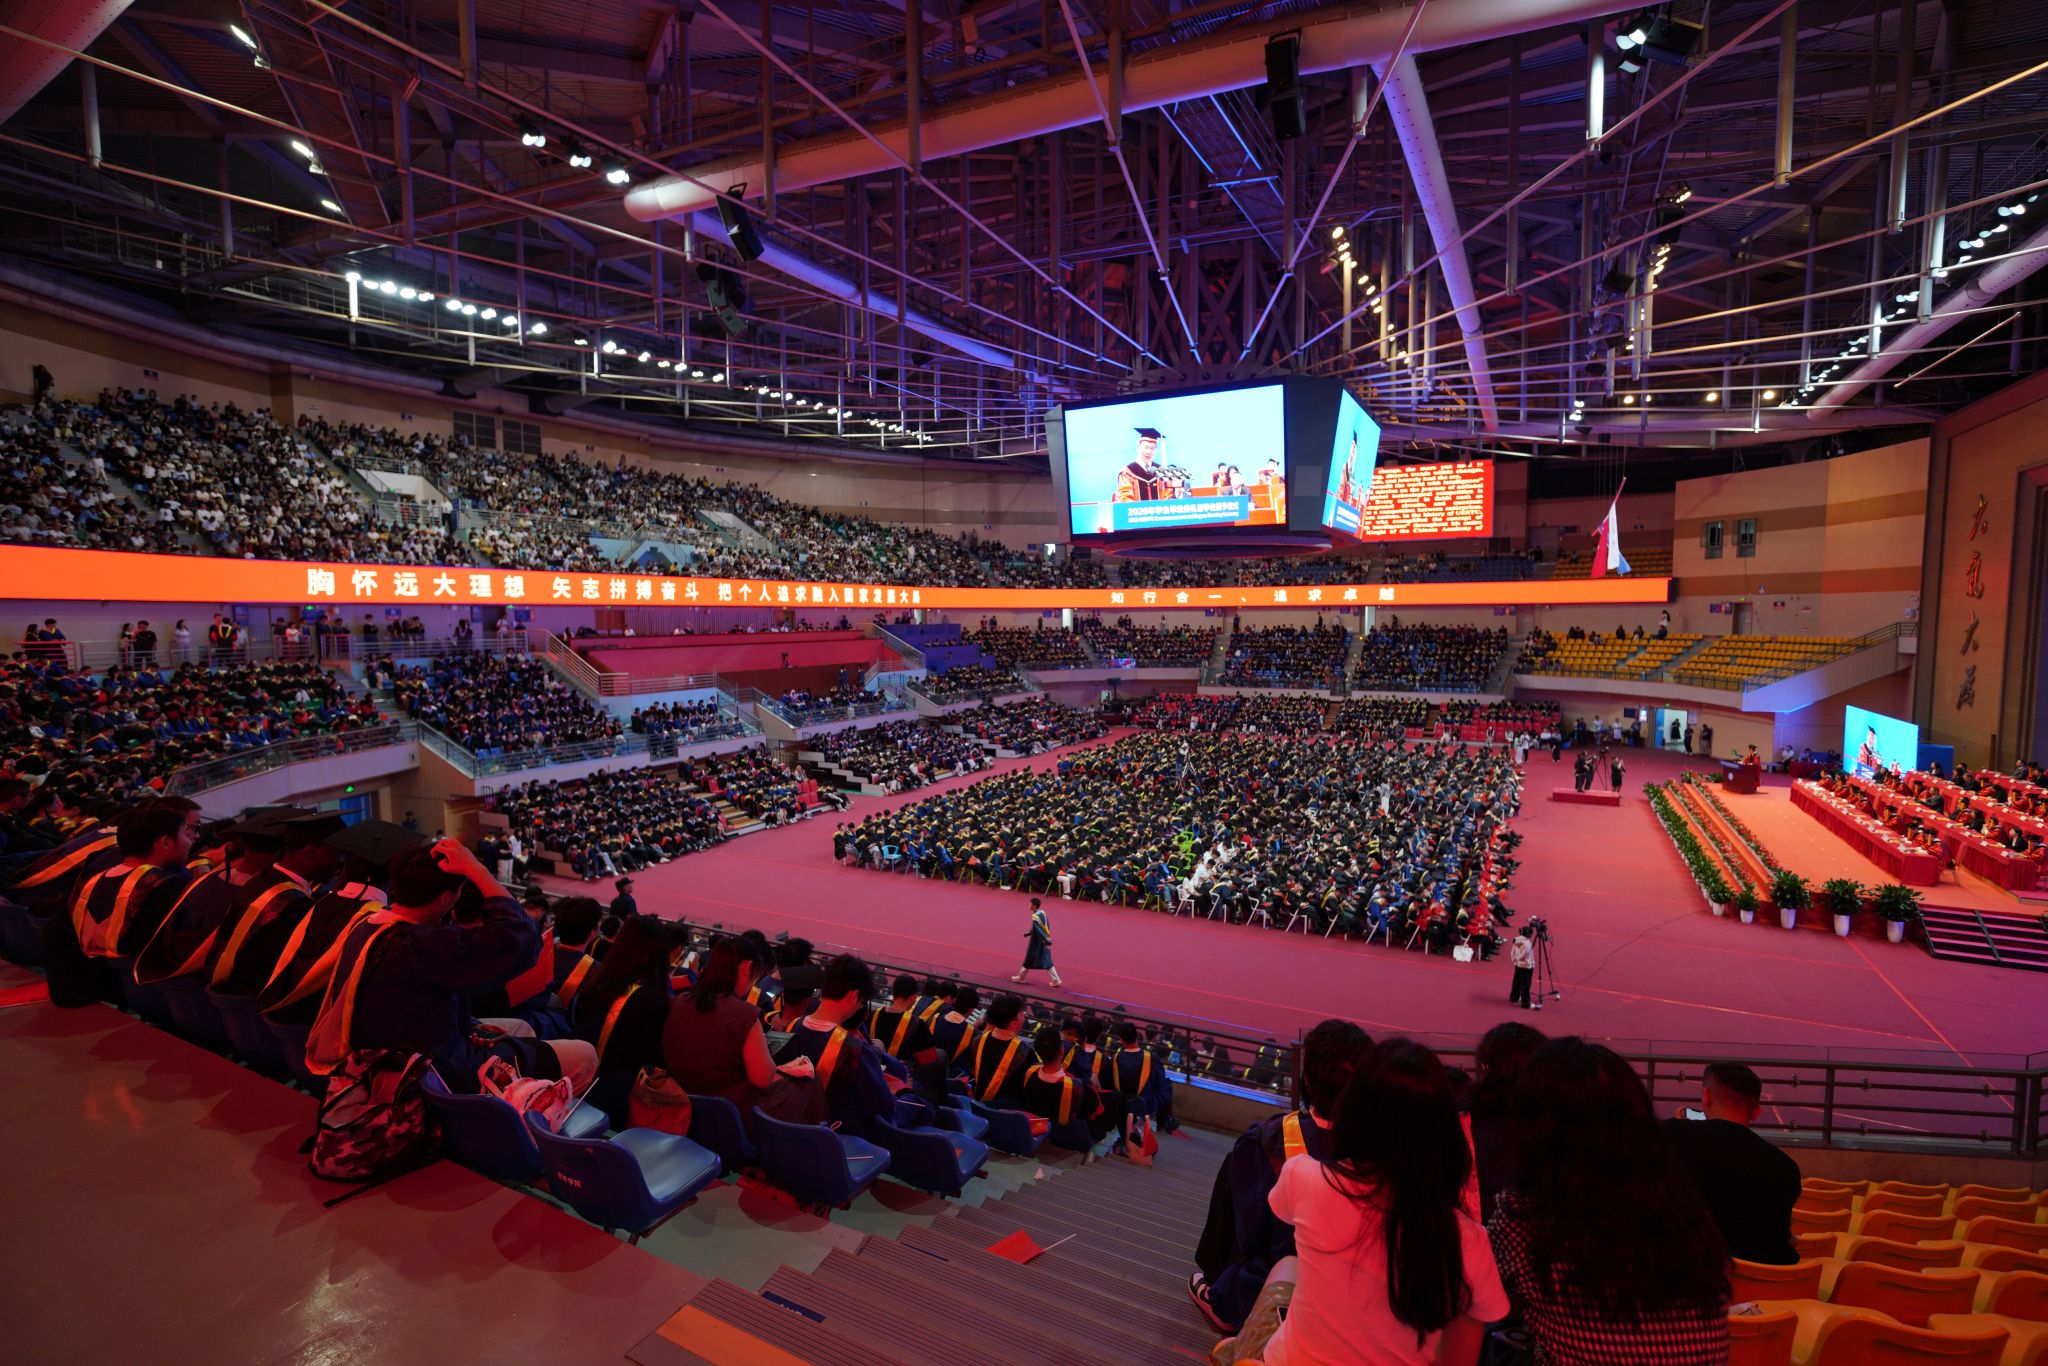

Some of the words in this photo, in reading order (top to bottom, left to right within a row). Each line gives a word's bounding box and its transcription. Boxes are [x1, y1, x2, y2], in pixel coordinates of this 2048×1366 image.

[307, 568, 525, 598] 胸怀远大理想
[552, 575, 700, 601] 矢志拼搏奋斗
[718, 581, 921, 604] 把个人追求融入国家发展大局
[1111, 587, 1396, 604] 知行合一、追求卓越
